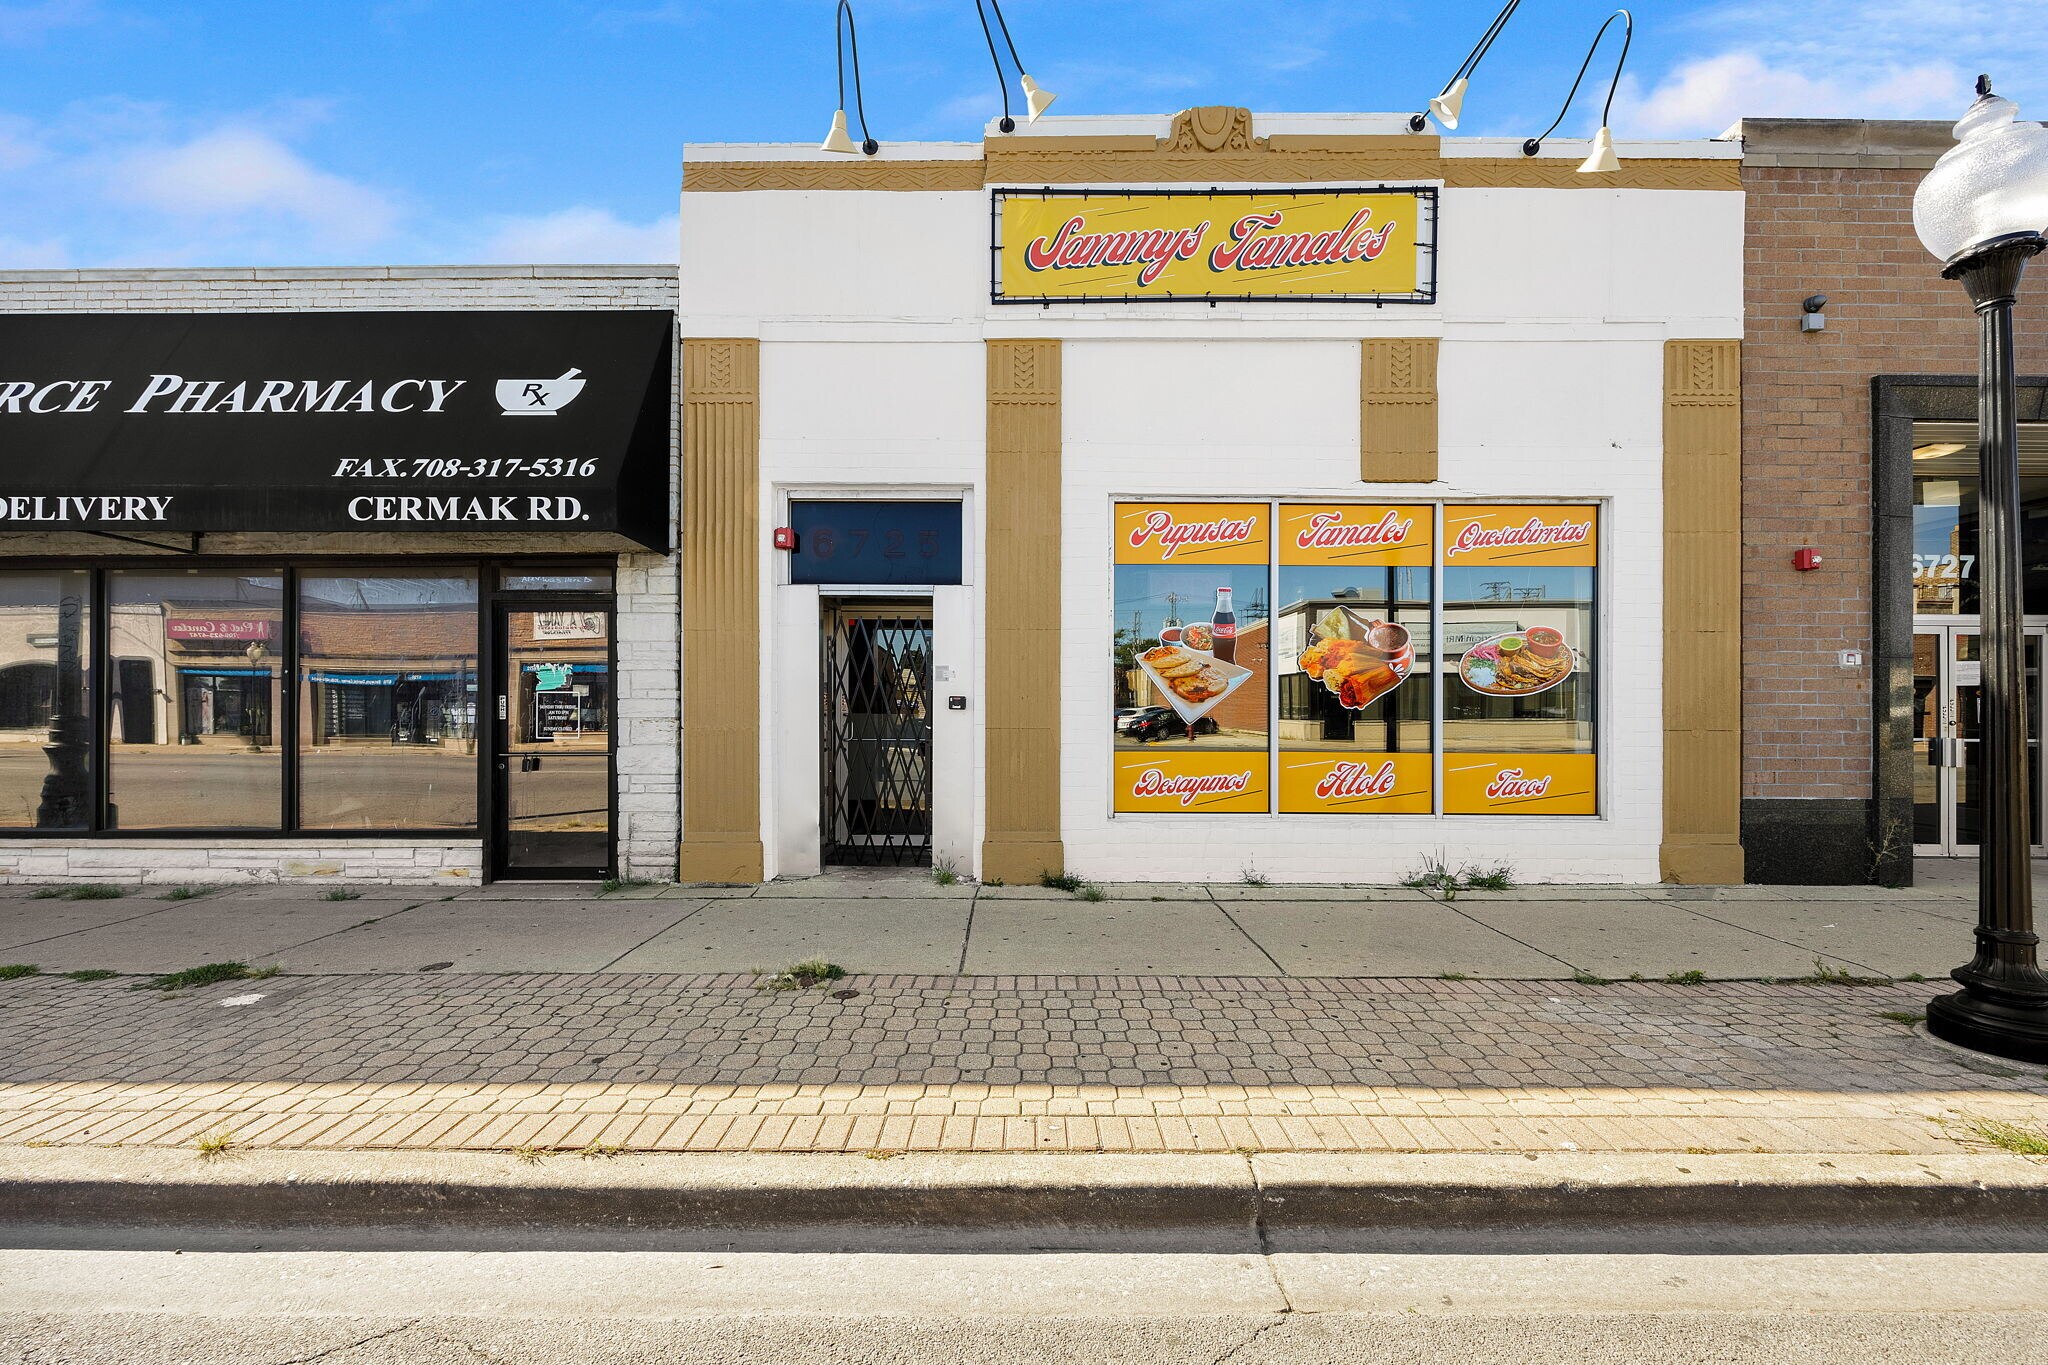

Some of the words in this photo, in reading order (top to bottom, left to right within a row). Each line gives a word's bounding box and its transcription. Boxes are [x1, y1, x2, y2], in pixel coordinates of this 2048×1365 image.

[1025, 216, 1210, 287] Sammys
[1208, 207, 1395, 273] Tamales
[347, 496, 518, 521] CERMAK
[527, 496, 590, 521] RD.
[812, 529, 940, 559] 6725
[1129, 510, 1256, 560] Pupusas
[1296, 509, 1413, 548] Tamales
[1448, 516, 1591, 558] Quesabirrias
[1133, 768, 1251, 806] Desayunos
[1315, 760, 1395, 798] Atole
[1486, 768, 1551, 799] Tacos
